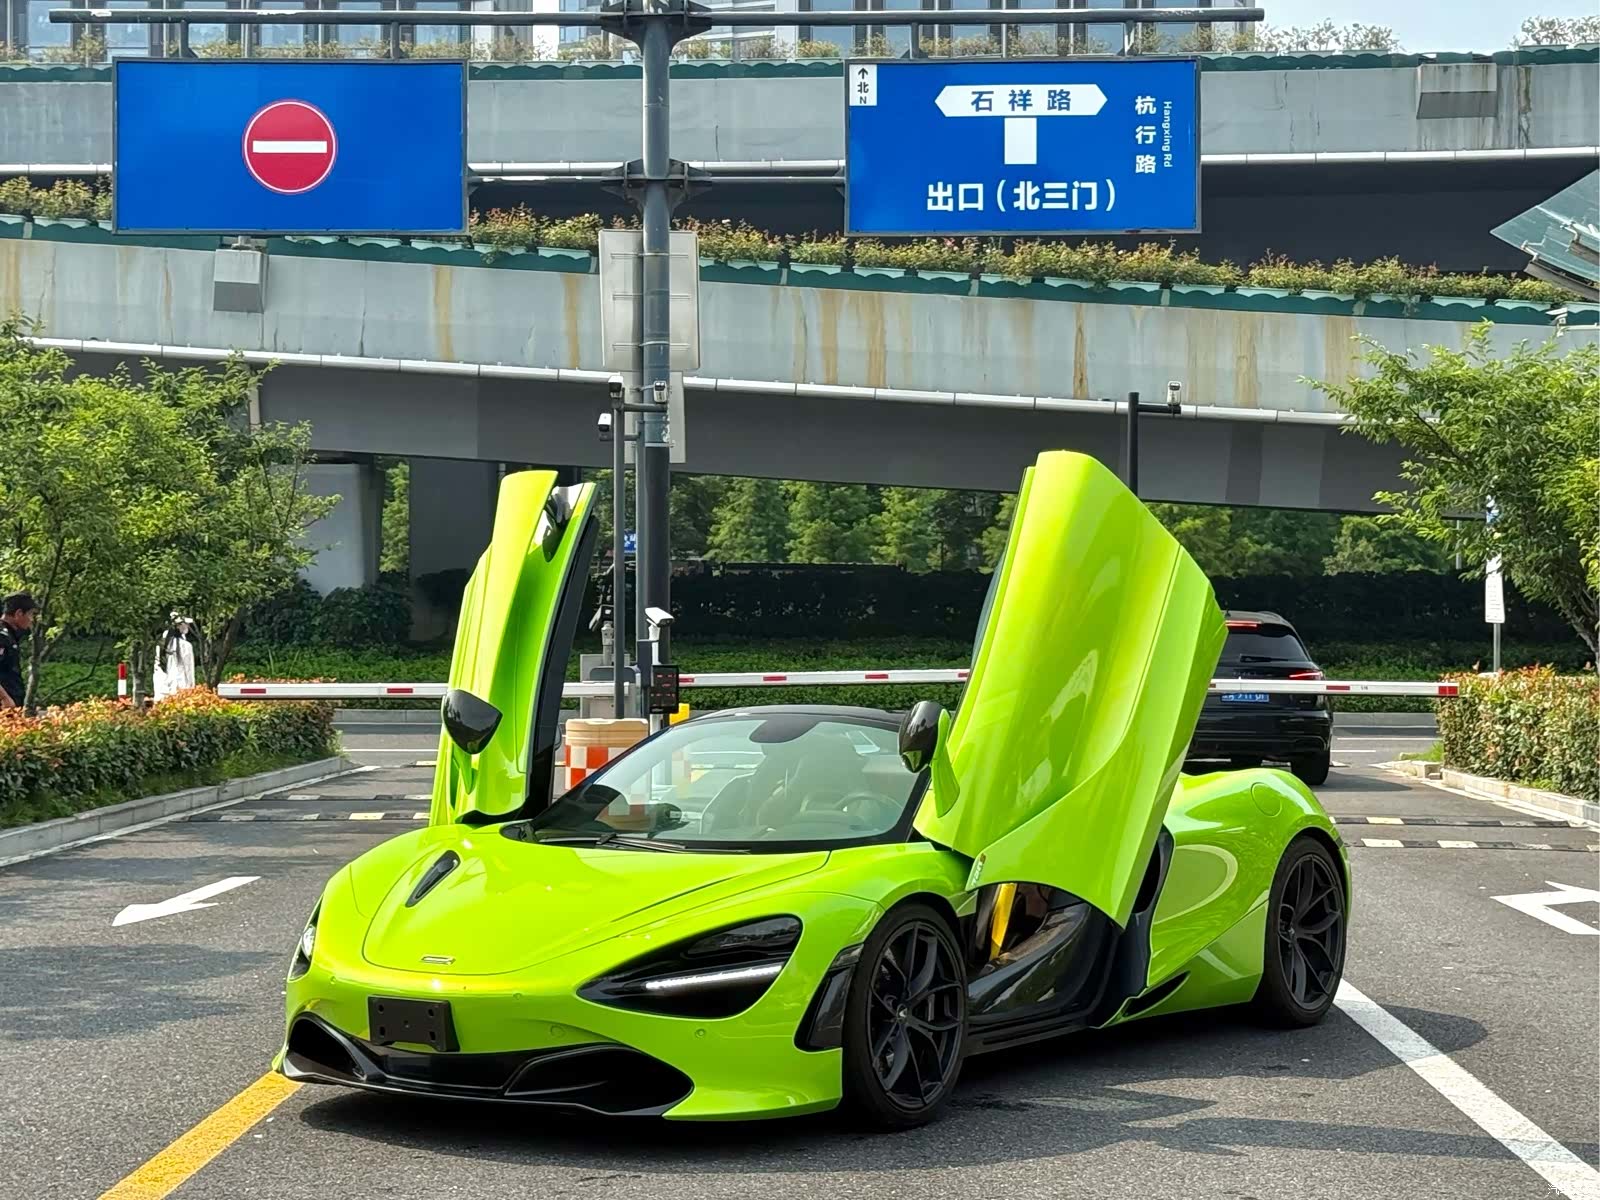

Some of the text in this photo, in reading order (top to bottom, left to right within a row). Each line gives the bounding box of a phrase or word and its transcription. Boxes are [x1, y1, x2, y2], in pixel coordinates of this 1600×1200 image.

[857, 81, 870, 94] 北
[859, 95, 867, 105] N
[970, 88, 1072, 113] 石祥路
[1135, 95, 1157, 174] 杭行路
[1161, 101, 1173, 168] Hangxing Rd
[926, 178, 1117, 212] 出口（北三门）
